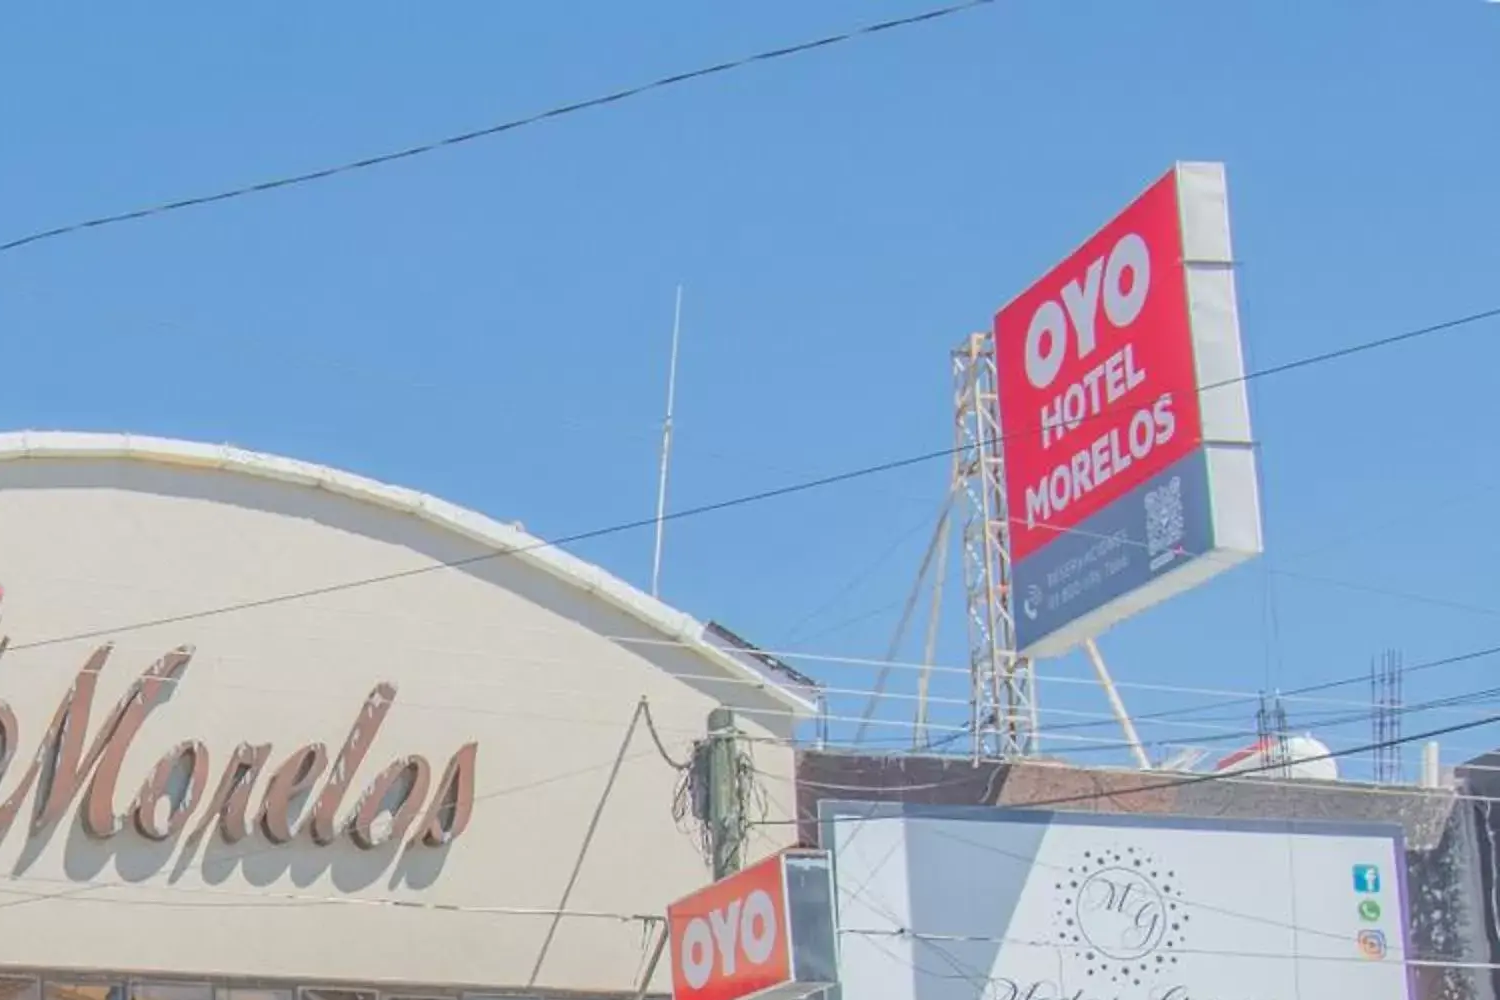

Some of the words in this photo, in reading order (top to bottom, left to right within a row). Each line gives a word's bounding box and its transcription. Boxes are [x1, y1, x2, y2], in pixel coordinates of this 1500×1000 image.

[1024, 232, 1151, 389] OYO
[1040, 343, 1146, 449] HOTEL
[1024, 392, 1176, 532] MORELOS
[681, 889, 777, 990] OYO
